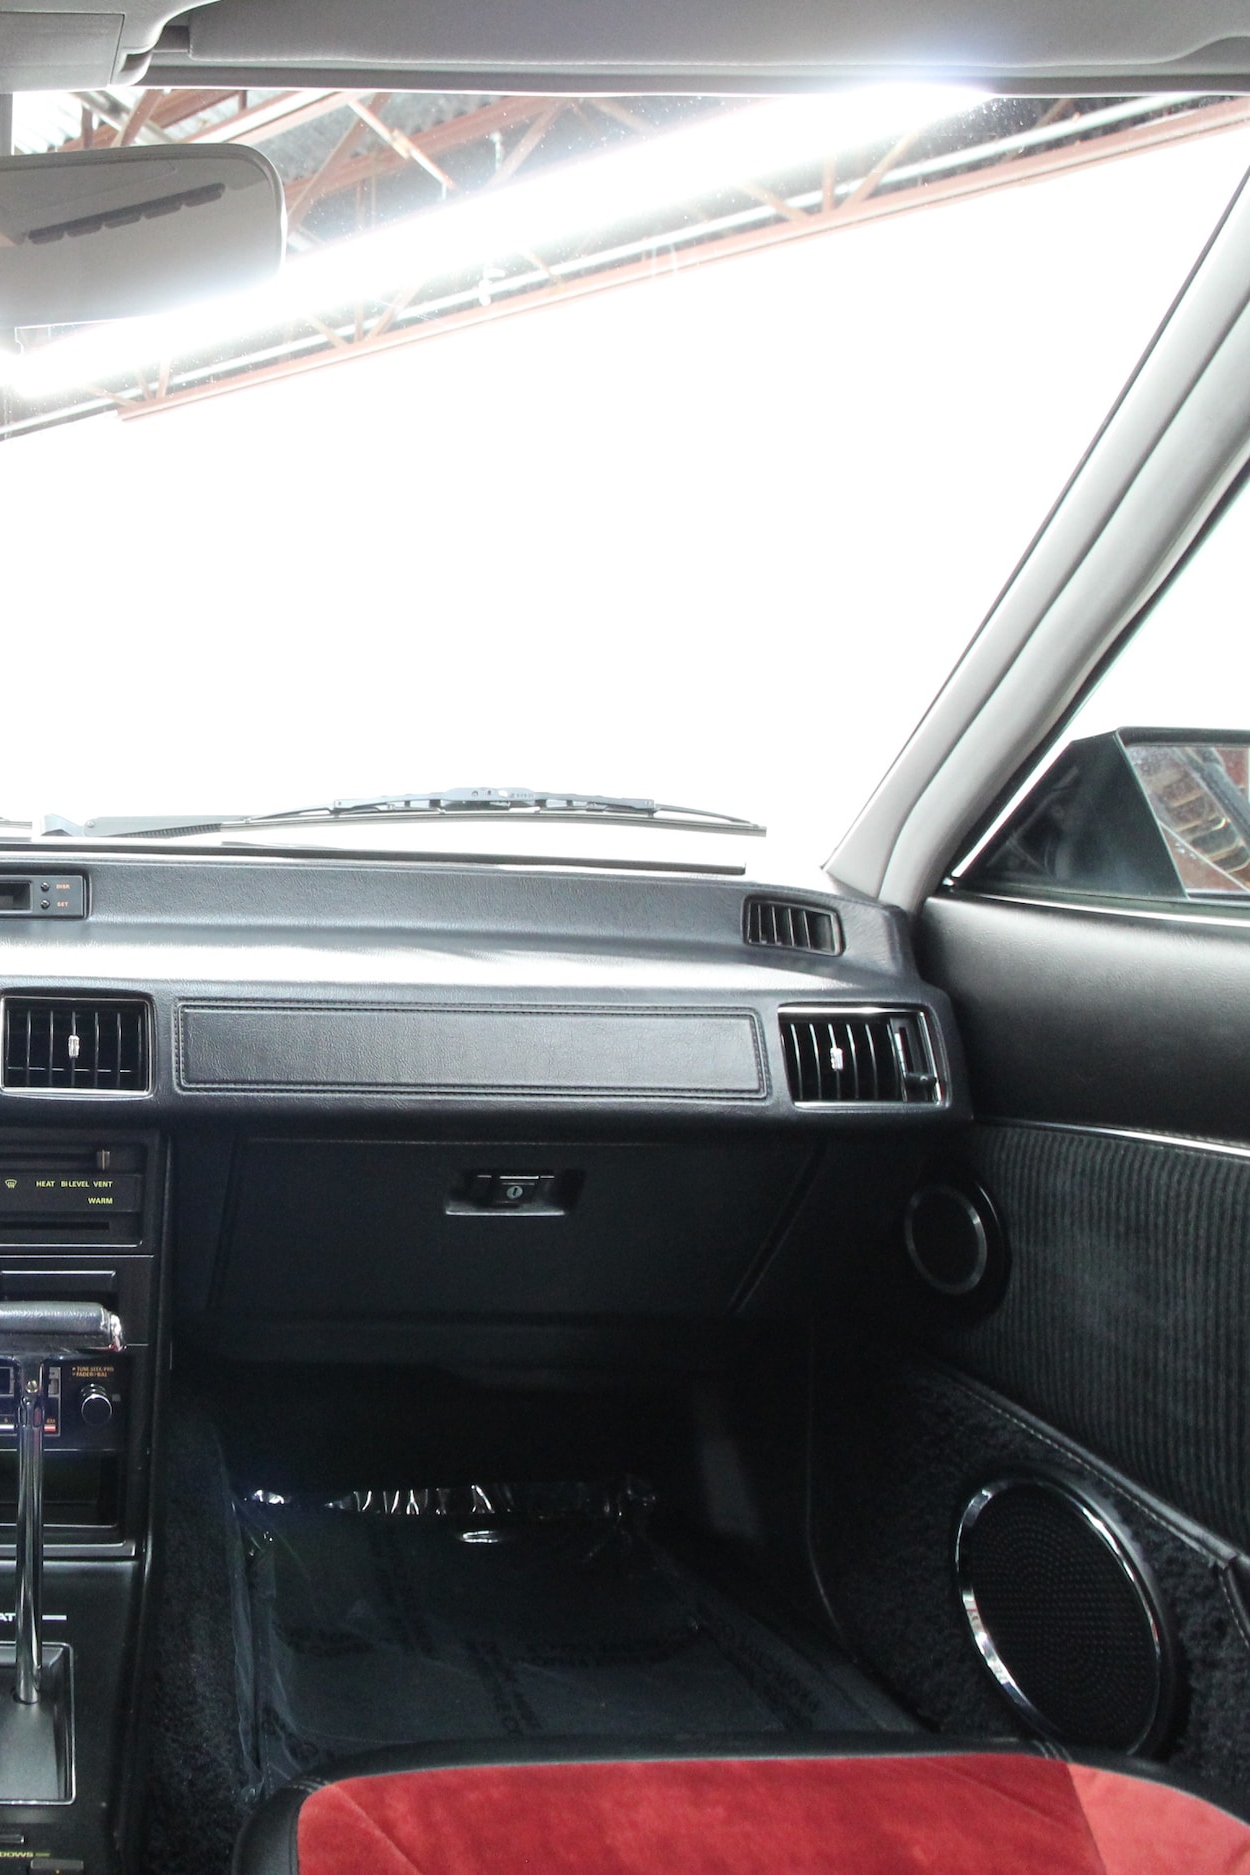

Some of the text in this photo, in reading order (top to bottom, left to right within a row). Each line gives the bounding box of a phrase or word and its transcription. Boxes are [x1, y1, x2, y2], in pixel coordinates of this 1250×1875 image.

[56, 900, 69, 908] SET
[35, 1180, 56, 1189] HEAT
[92, 1180, 113, 1189] VENT
[87, 1197, 113, 1206] WARM
